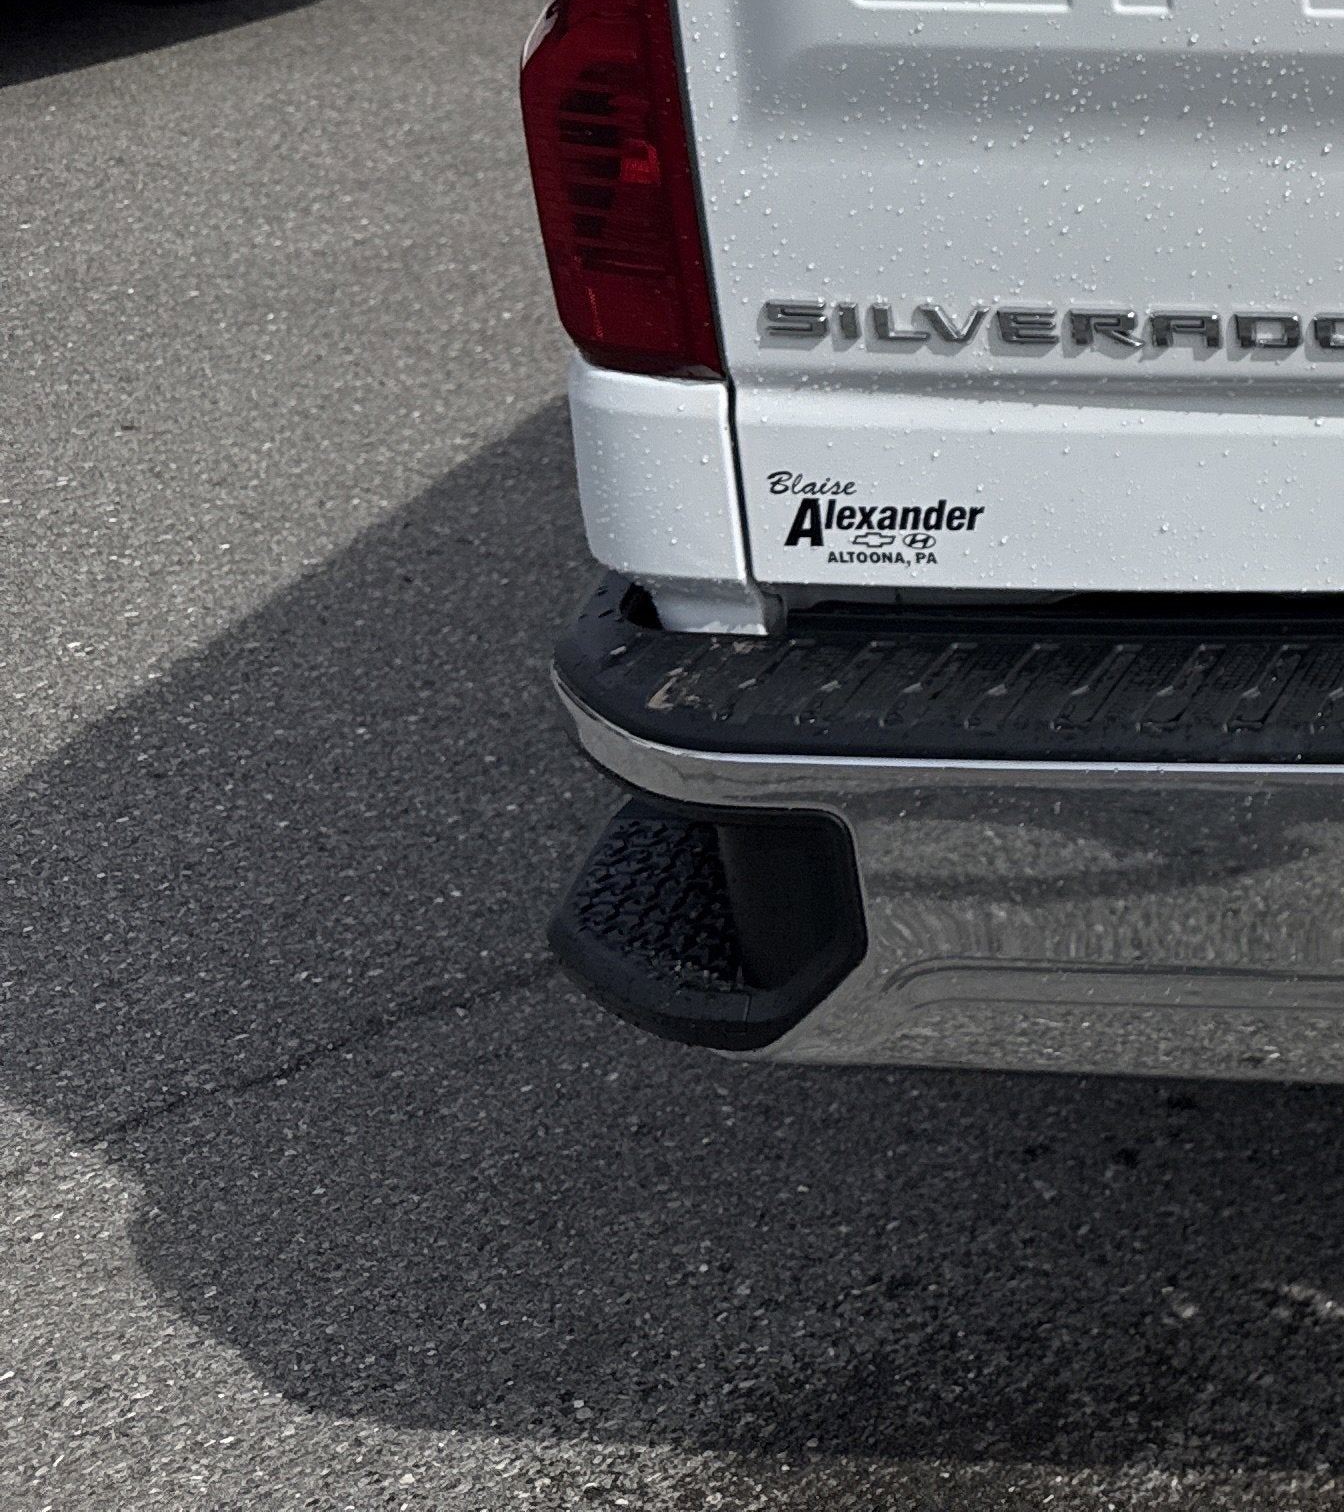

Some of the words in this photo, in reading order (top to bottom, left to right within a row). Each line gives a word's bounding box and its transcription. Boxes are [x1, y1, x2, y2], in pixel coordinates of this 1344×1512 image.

[767, 471, 857, 495] Blaise
[784, 498, 985, 547] Alexander
[828, 551, 911, 566] ALTOONA,
[915, 552, 938, 564] PA
